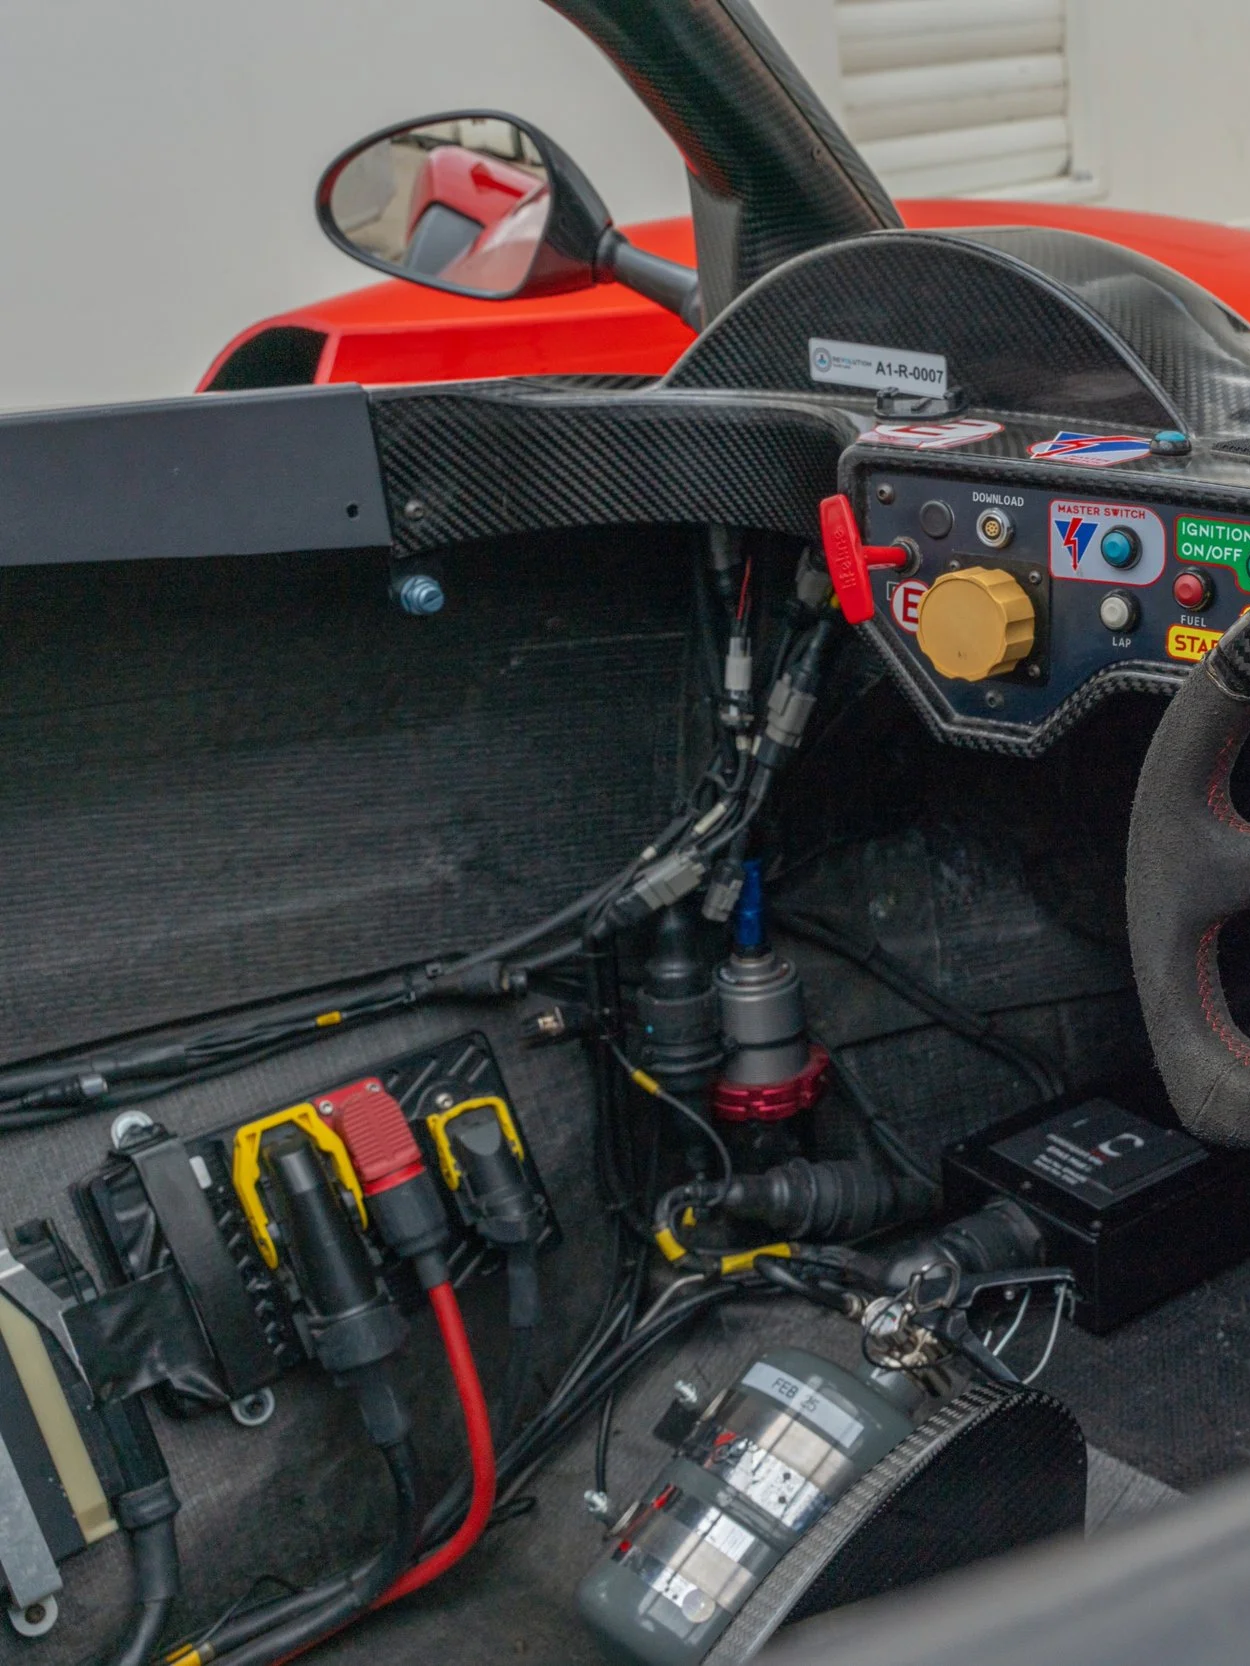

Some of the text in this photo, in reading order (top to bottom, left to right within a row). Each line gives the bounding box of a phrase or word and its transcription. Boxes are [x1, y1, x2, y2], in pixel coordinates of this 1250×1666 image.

[875, 360, 944, 384] A1-R-0007
[972, 491, 1025, 507] DOWNLOAD
[1057, 504, 1146, 519] MASTER SWITCH
[1181, 542, 1243, 562] ON/OFF
[902, 587, 926, 624] E
[1180, 614, 1207, 628] FUEL
[1111, 636, 1132, 649] LAP
[771, 1377, 820, 1413] FEB 25
